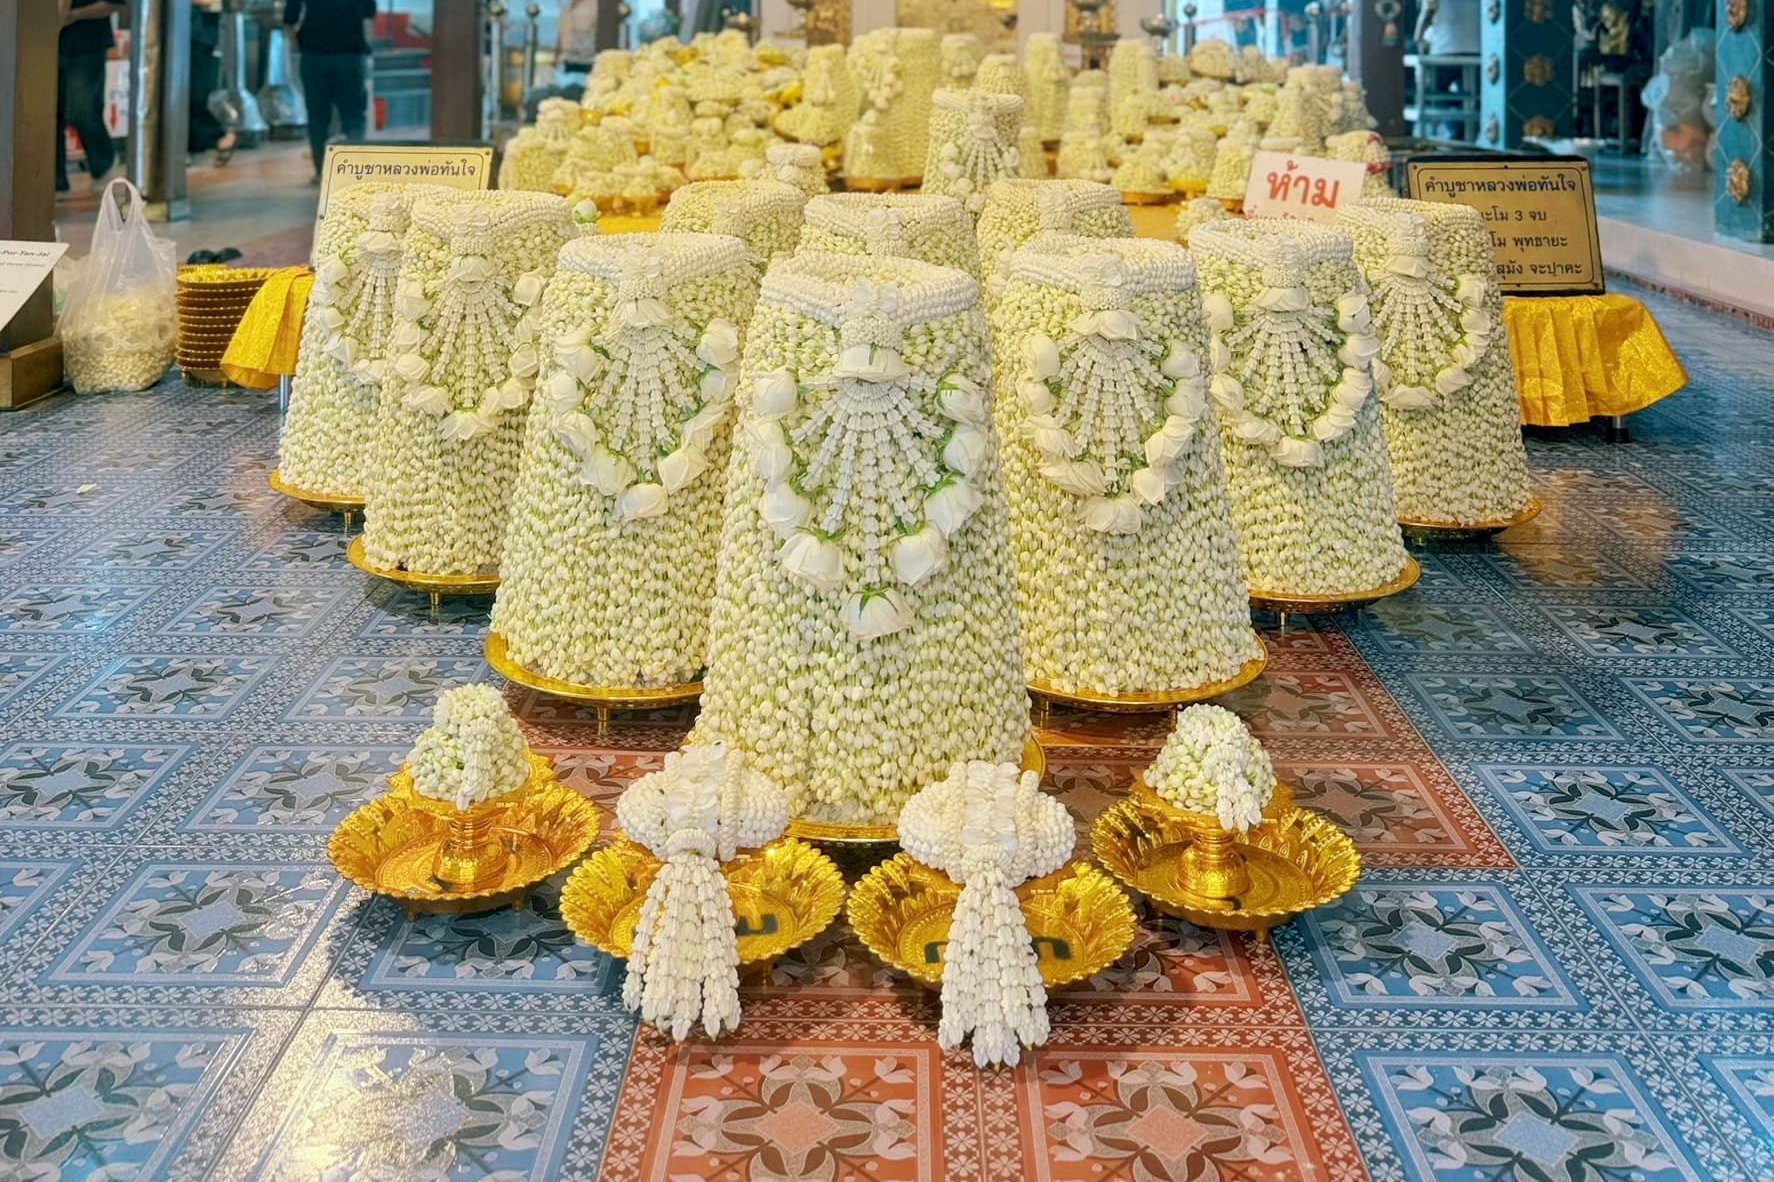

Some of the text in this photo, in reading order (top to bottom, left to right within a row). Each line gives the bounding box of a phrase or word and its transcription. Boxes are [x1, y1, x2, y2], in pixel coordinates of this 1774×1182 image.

[337, 159, 476, 180] คำบูชาหลวงพ่อทันใจ
[1267, 160, 1340, 209] ห้าม
[1425, 174, 1576, 198] คำบูชาหลวงพ่อทันใจ
[1514, 210, 1523, 221] 3
[1529, 210, 1547, 221] จบ
[1513, 237, 1568, 252] พุทธายะ
